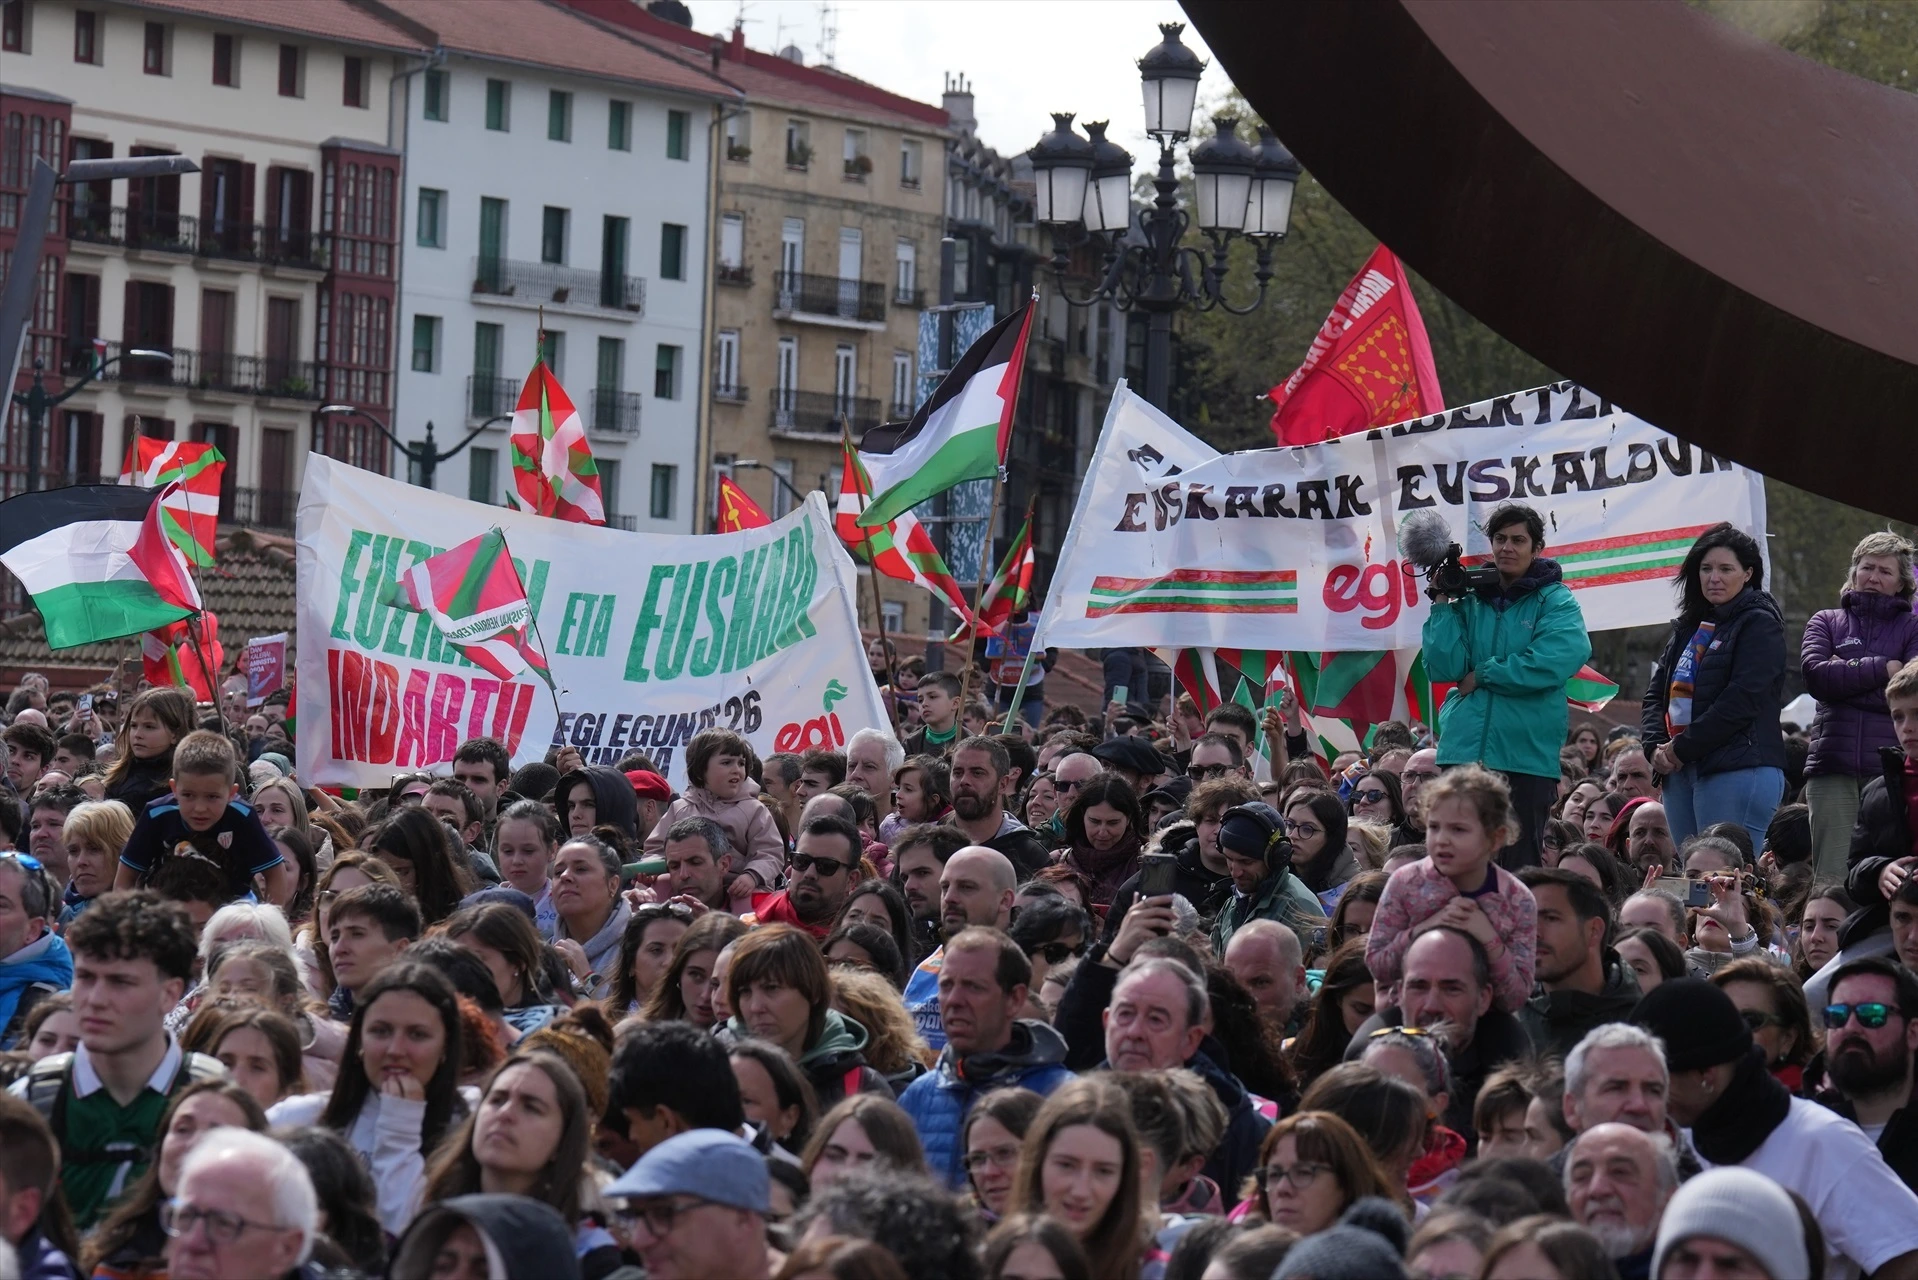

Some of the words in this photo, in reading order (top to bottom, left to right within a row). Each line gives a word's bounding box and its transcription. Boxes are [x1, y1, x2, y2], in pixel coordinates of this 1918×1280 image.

[555, 592, 616, 657] ETA
[1322, 559, 1419, 630] egi
[327, 648, 536, 769] INDARTU
[552, 712, 607, 745] EGI
